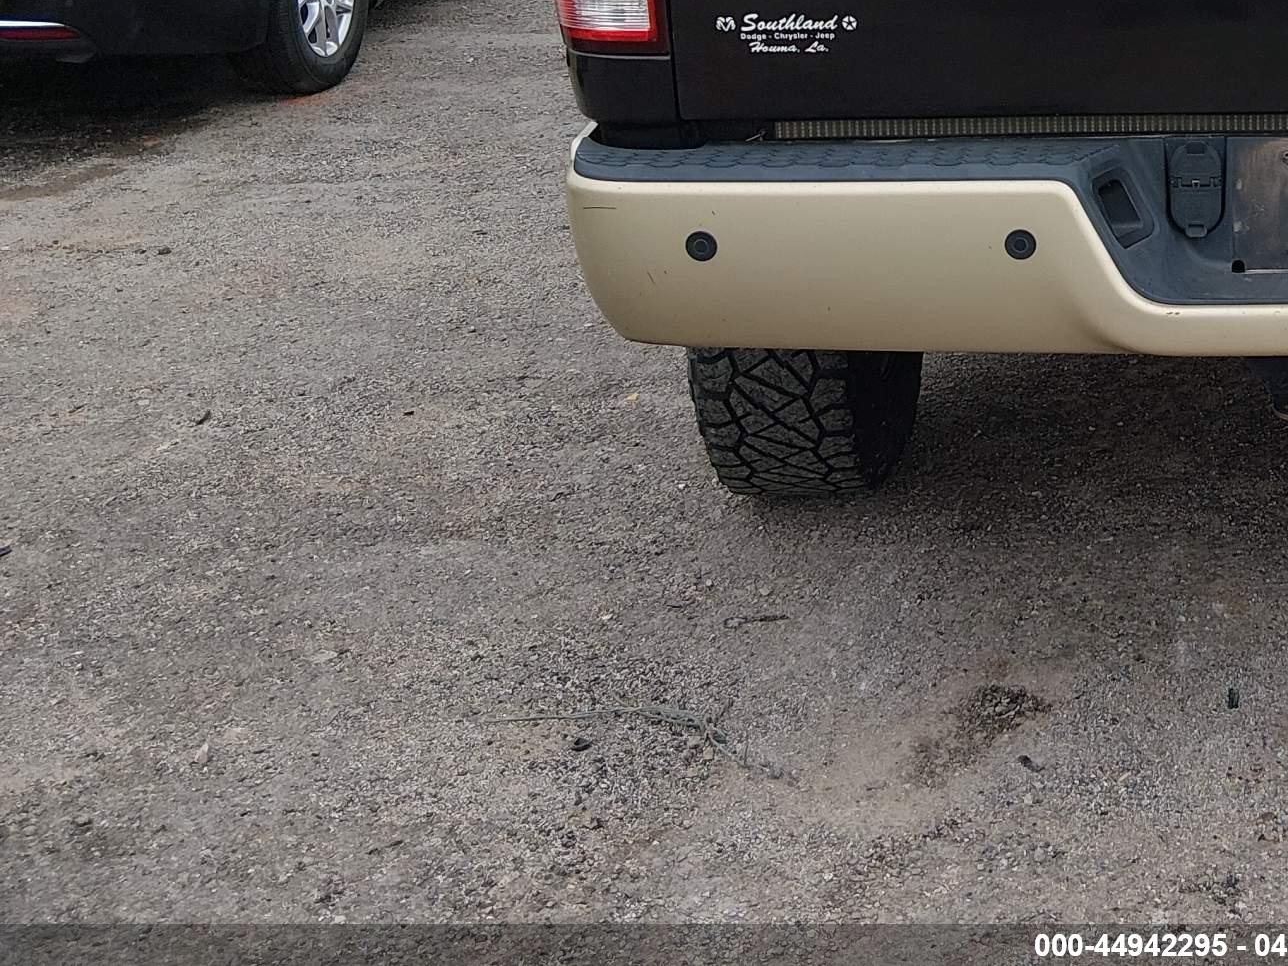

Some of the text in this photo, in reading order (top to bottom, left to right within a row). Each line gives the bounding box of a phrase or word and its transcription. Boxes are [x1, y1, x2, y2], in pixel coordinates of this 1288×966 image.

[740, 13, 839, 32] Southland
[740, 32, 767, 41] Dodge
[774, 32, 808, 41] Chrysler
[815, 32, 836, 41] Jeep
[804, 40, 829, 53] La.
